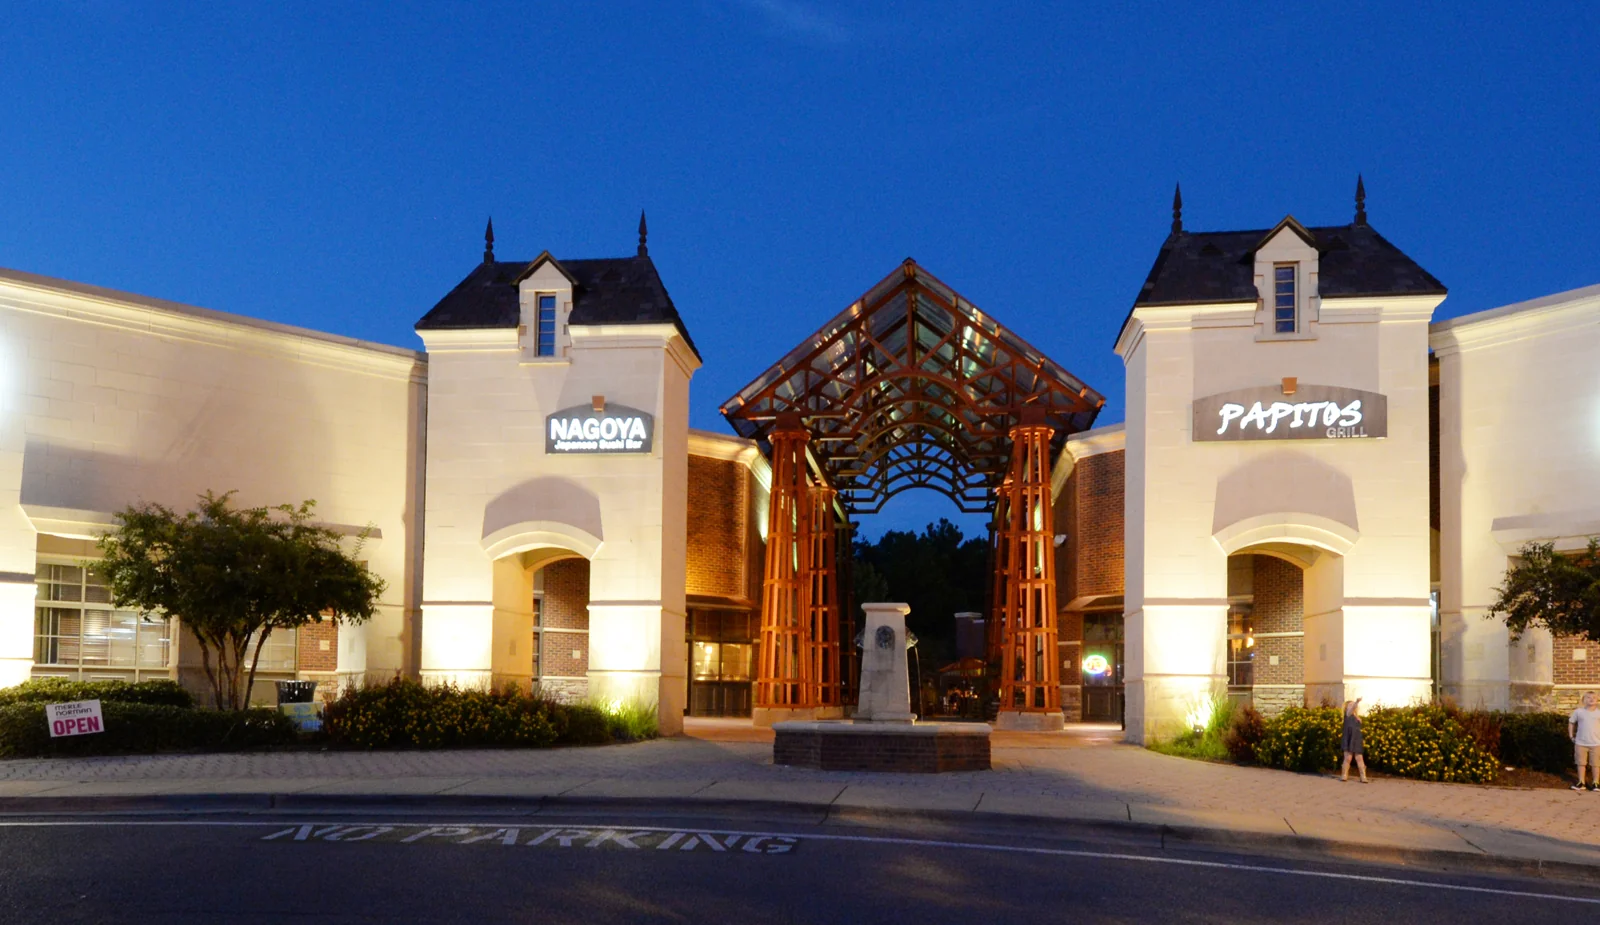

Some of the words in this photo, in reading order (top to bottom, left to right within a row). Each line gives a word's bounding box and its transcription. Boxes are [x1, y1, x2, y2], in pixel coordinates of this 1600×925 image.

[550, 417, 646, 440] NAGOYA
[1217, 400, 1362, 434] PAPITOS
[1326, 427, 1368, 438] GRILL
[53, 716, 99, 735] OPEN
[260, 823, 394, 842] NO
[401, 825, 798, 854] PARKING
